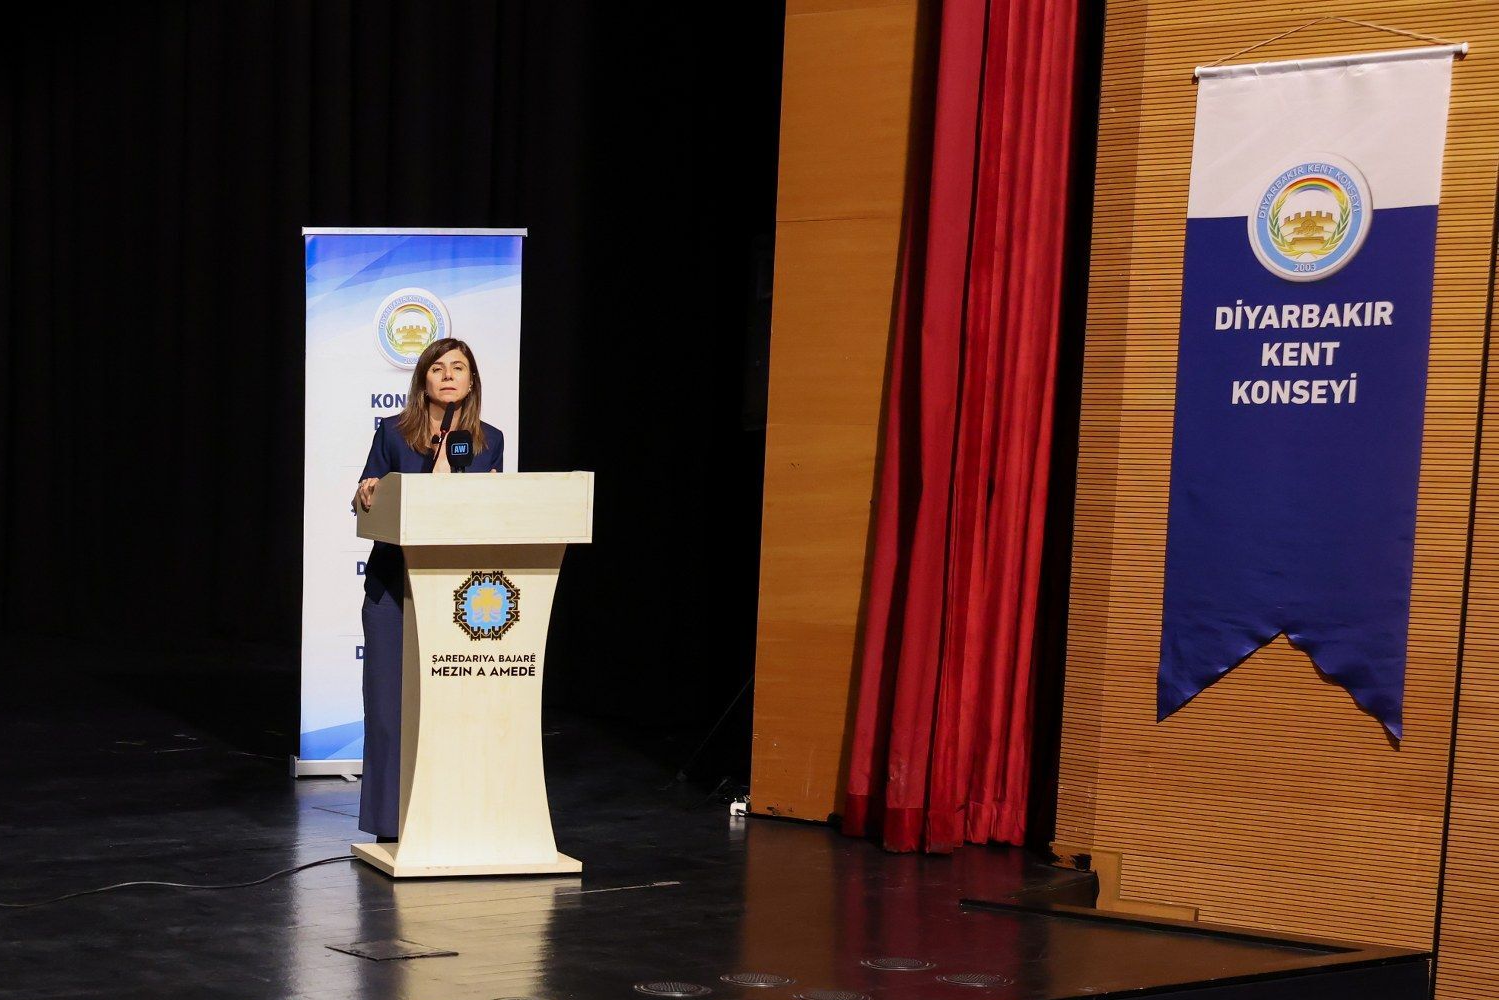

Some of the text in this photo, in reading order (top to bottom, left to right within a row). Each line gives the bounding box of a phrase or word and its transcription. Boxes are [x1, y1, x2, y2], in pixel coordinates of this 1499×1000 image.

[1307, 163, 1333, 175] KENT
[1214, 299, 1395, 331] DİYARBAKIR
[1260, 341, 1341, 368] KENT
[1231, 373, 1359, 405] KONSEYİ
[454, 445, 466, 453] AW
[431, 664, 536, 677] MEZIN A AMEDÊ
